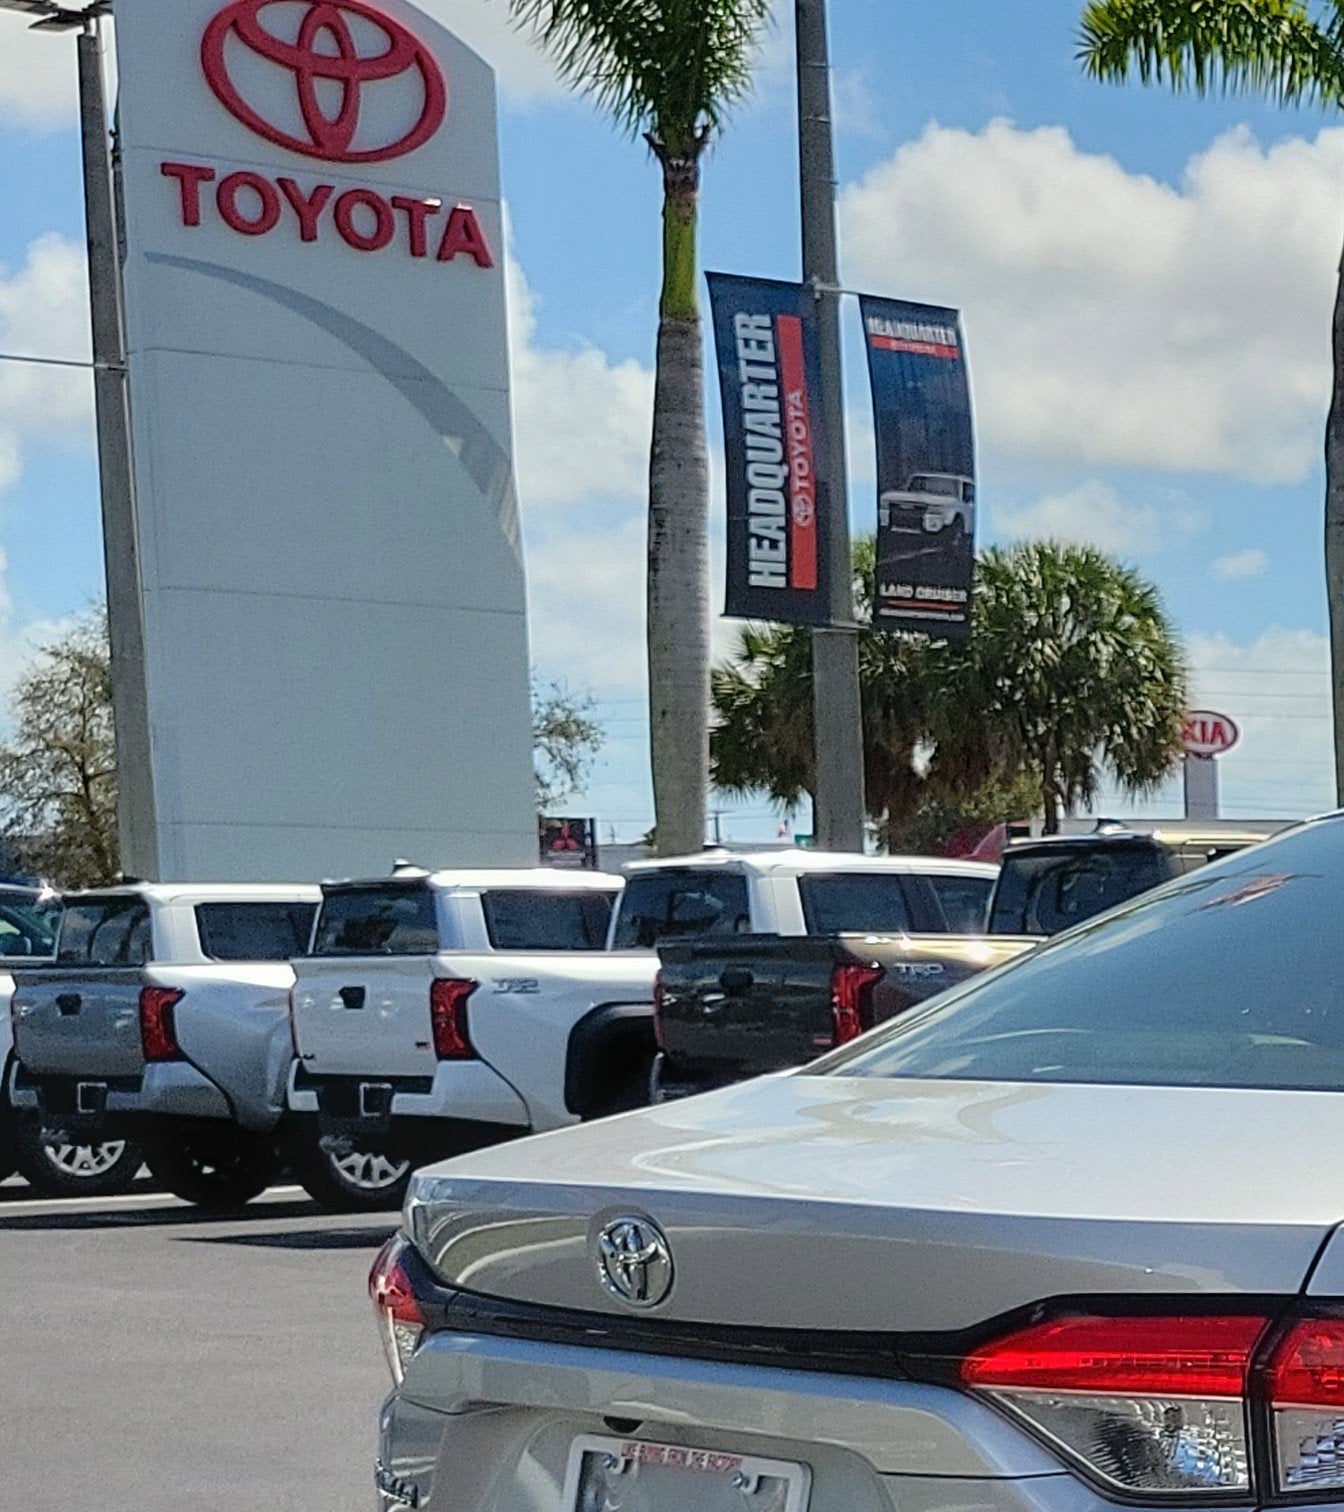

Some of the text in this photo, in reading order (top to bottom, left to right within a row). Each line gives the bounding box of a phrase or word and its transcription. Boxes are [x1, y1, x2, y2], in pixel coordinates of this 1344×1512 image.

[161, 162, 493, 268] TOYOTA
[734, 312, 789, 589] HEADQUARTER
[786, 390, 810, 490] TOYOTA
[880, 582, 914, 598] LAND
[1183, 720, 1229, 747] KIA
